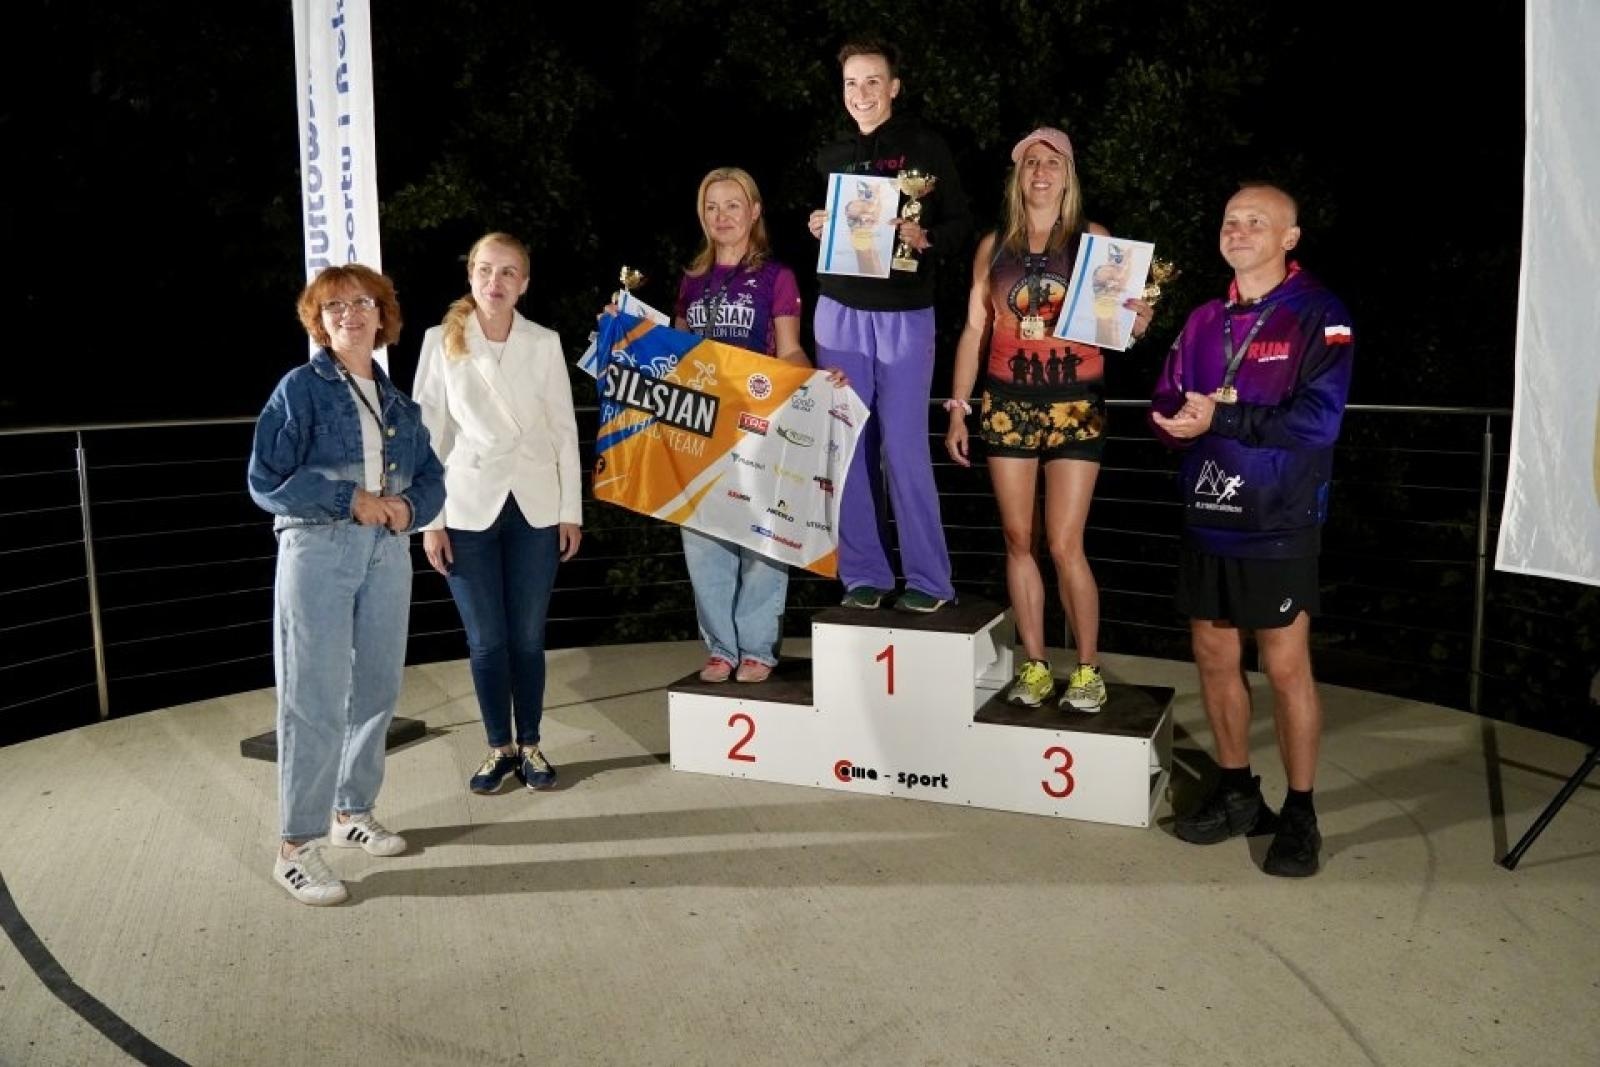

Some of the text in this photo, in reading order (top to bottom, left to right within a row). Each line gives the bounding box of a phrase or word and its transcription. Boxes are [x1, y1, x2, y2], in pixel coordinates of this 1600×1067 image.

[686, 306, 754, 328] SILSIAN
[1247, 341, 1290, 359] RUN
[666, 429, 706, 457] TEAM
[875, 644, 895, 695] 1
[727, 713, 757, 763] 2
[897, 772, 949, 788] sport
[1040, 746, 1075, 798] 3
